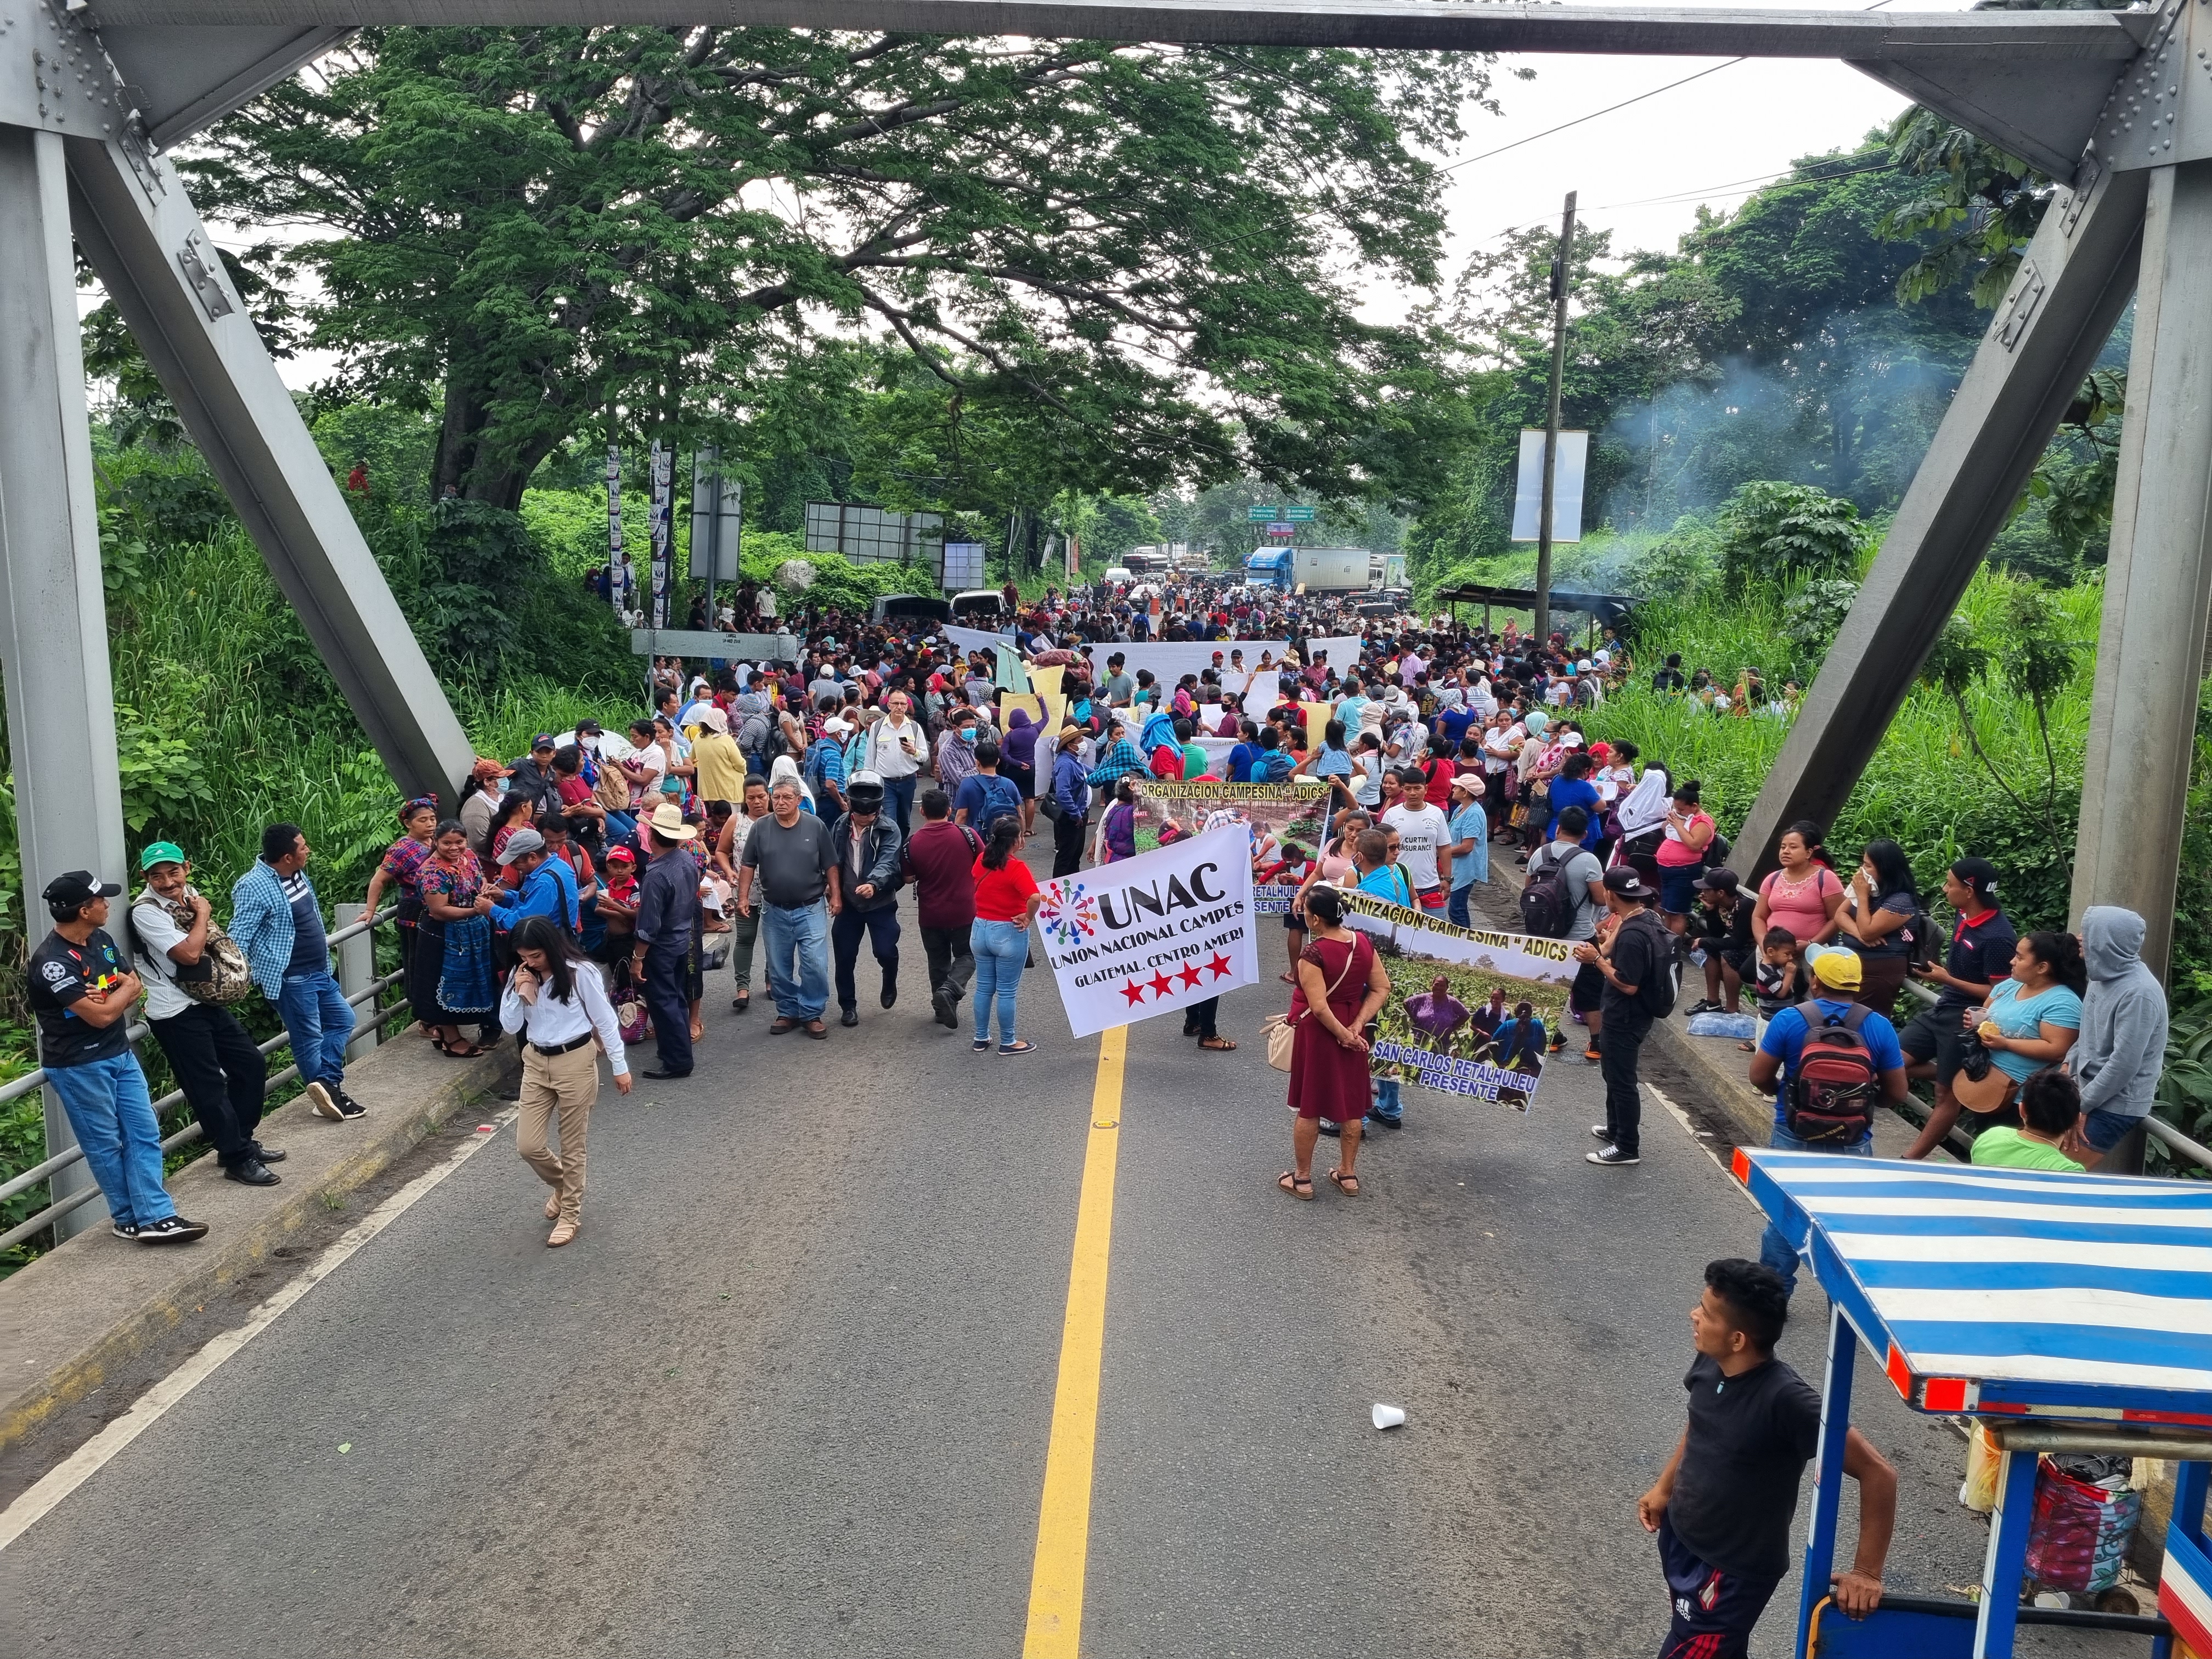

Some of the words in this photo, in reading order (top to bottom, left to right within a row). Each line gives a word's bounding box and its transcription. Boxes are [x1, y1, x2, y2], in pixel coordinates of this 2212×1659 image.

[1141, 783, 1223, 800] ORGANIZACION
[1223, 785, 1283, 800] CAMPESINA
[1097, 862, 1226, 930] UNAC
[1051, 945, 1099, 970] UNION
[1101, 923, 1178, 957] NACIONAL
[1180, 900, 1244, 933] CAMPES
[1075, 960, 1146, 988] GUATEMAL,
[1147, 943, 1200, 968] CENTRO
[1203, 927, 1244, 952] AMERI
[1427, 916, 1509, 950] CAMPESINA
[1522, 938, 1568, 962] ADICS
[1374, 1041, 1401, 1062] SAN
[1402, 1047, 1452, 1073] CARLOS
[1454, 1059, 1538, 1093] RETALHULEU
[1420, 1069, 1499, 1101] PRESENTE
